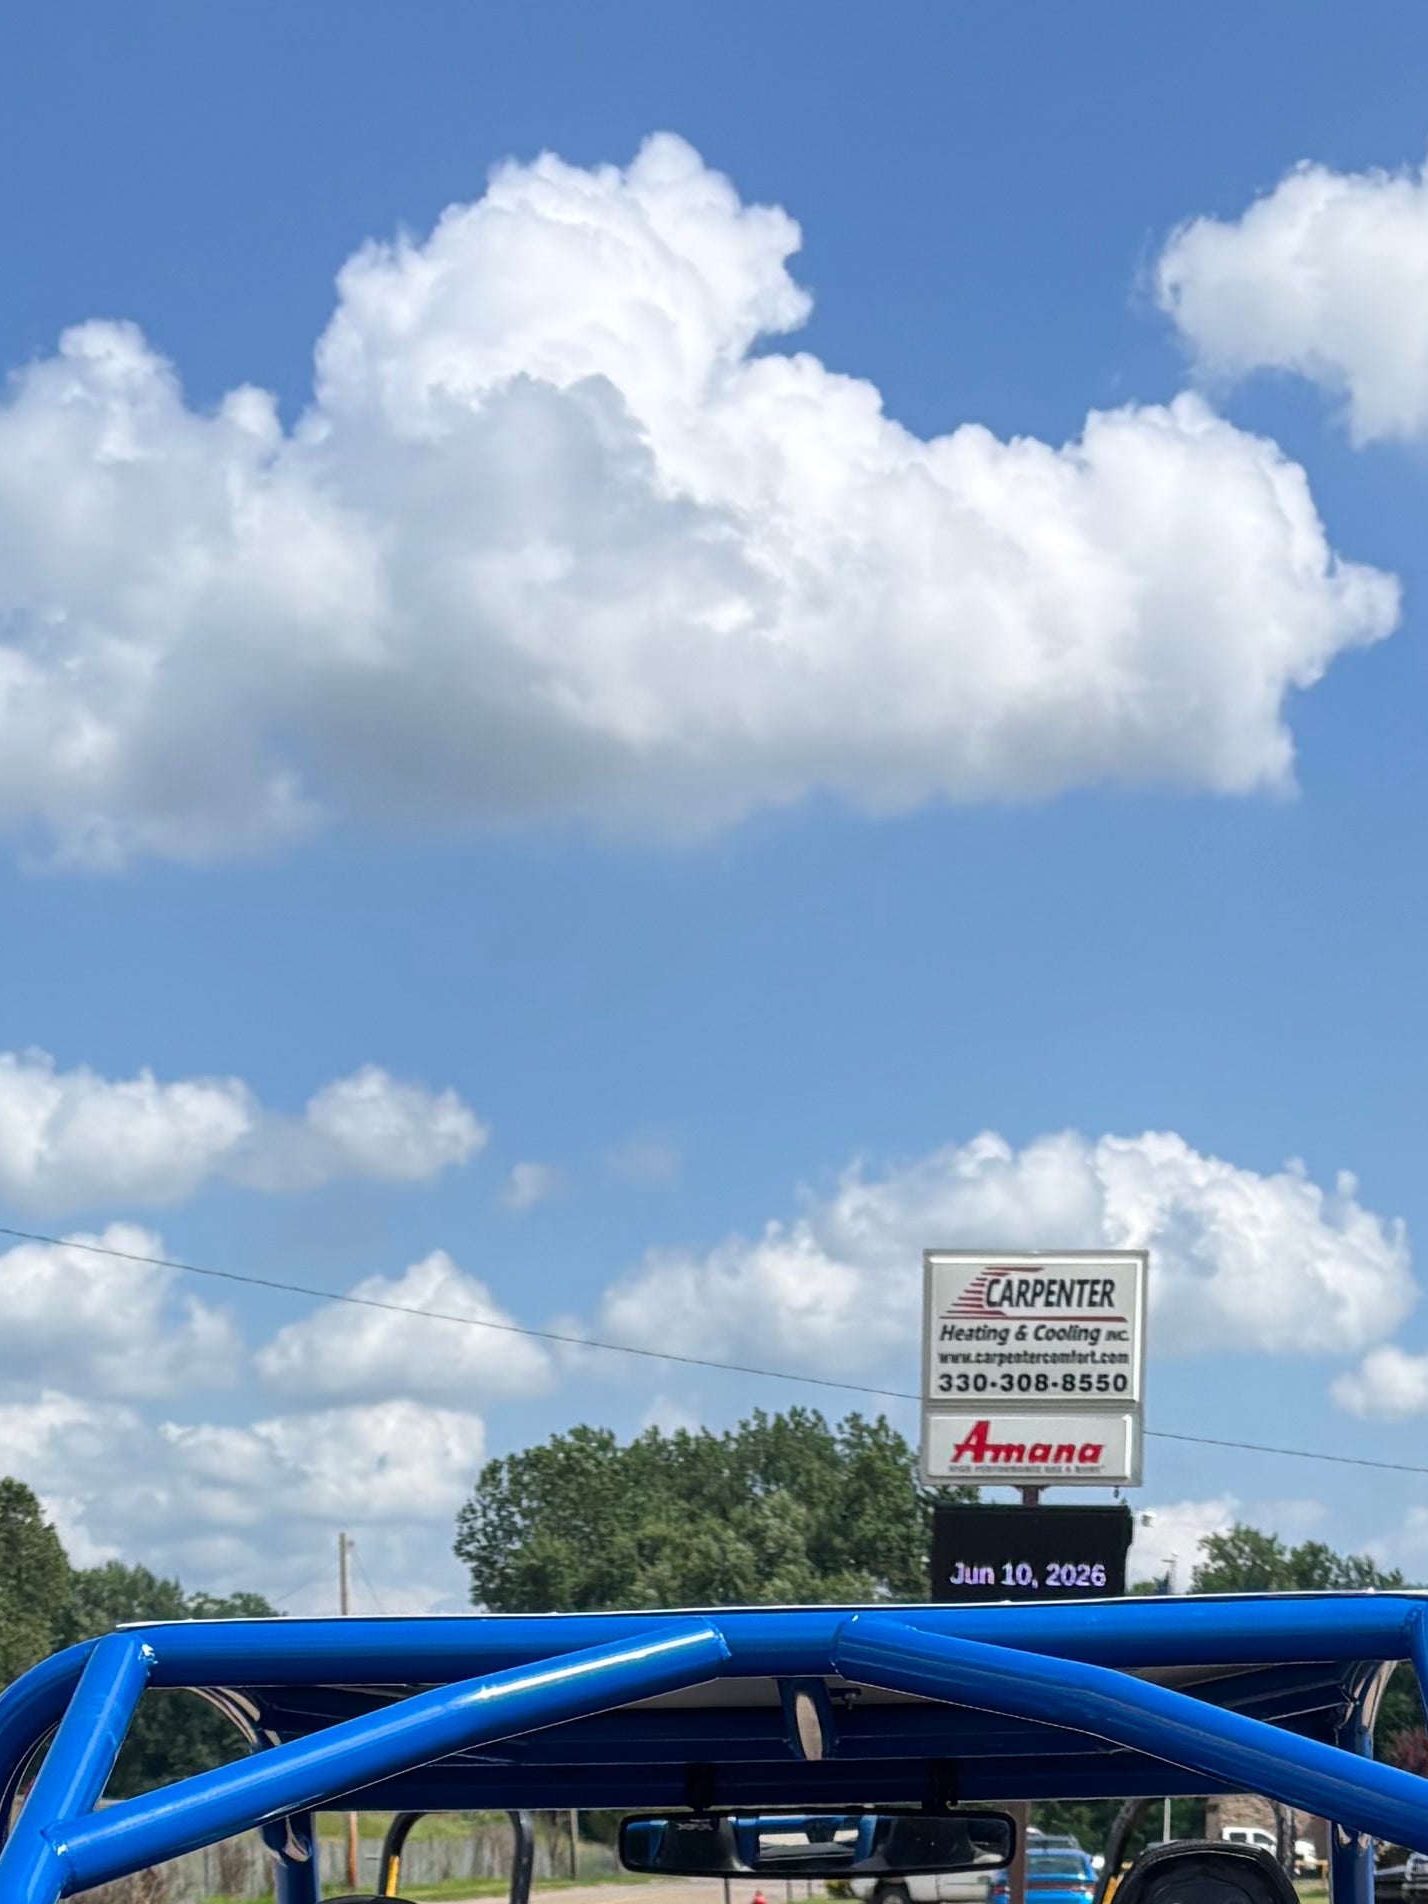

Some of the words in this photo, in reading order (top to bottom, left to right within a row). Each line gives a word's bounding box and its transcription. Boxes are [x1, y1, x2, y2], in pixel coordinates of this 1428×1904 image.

[985, 1278, 1116, 1309] CARPENTER
[939, 1324, 1011, 1346] Heating
[1014, 1324, 1028, 1342] &
[1033, 1324, 1102, 1346] Cooling
[950, 1420, 1105, 1464] Amana
[949, 1561, 995, 1587] Jun
[1001, 1562, 1039, 1589] 10,
[1045, 1562, 1107, 1587] 2026
